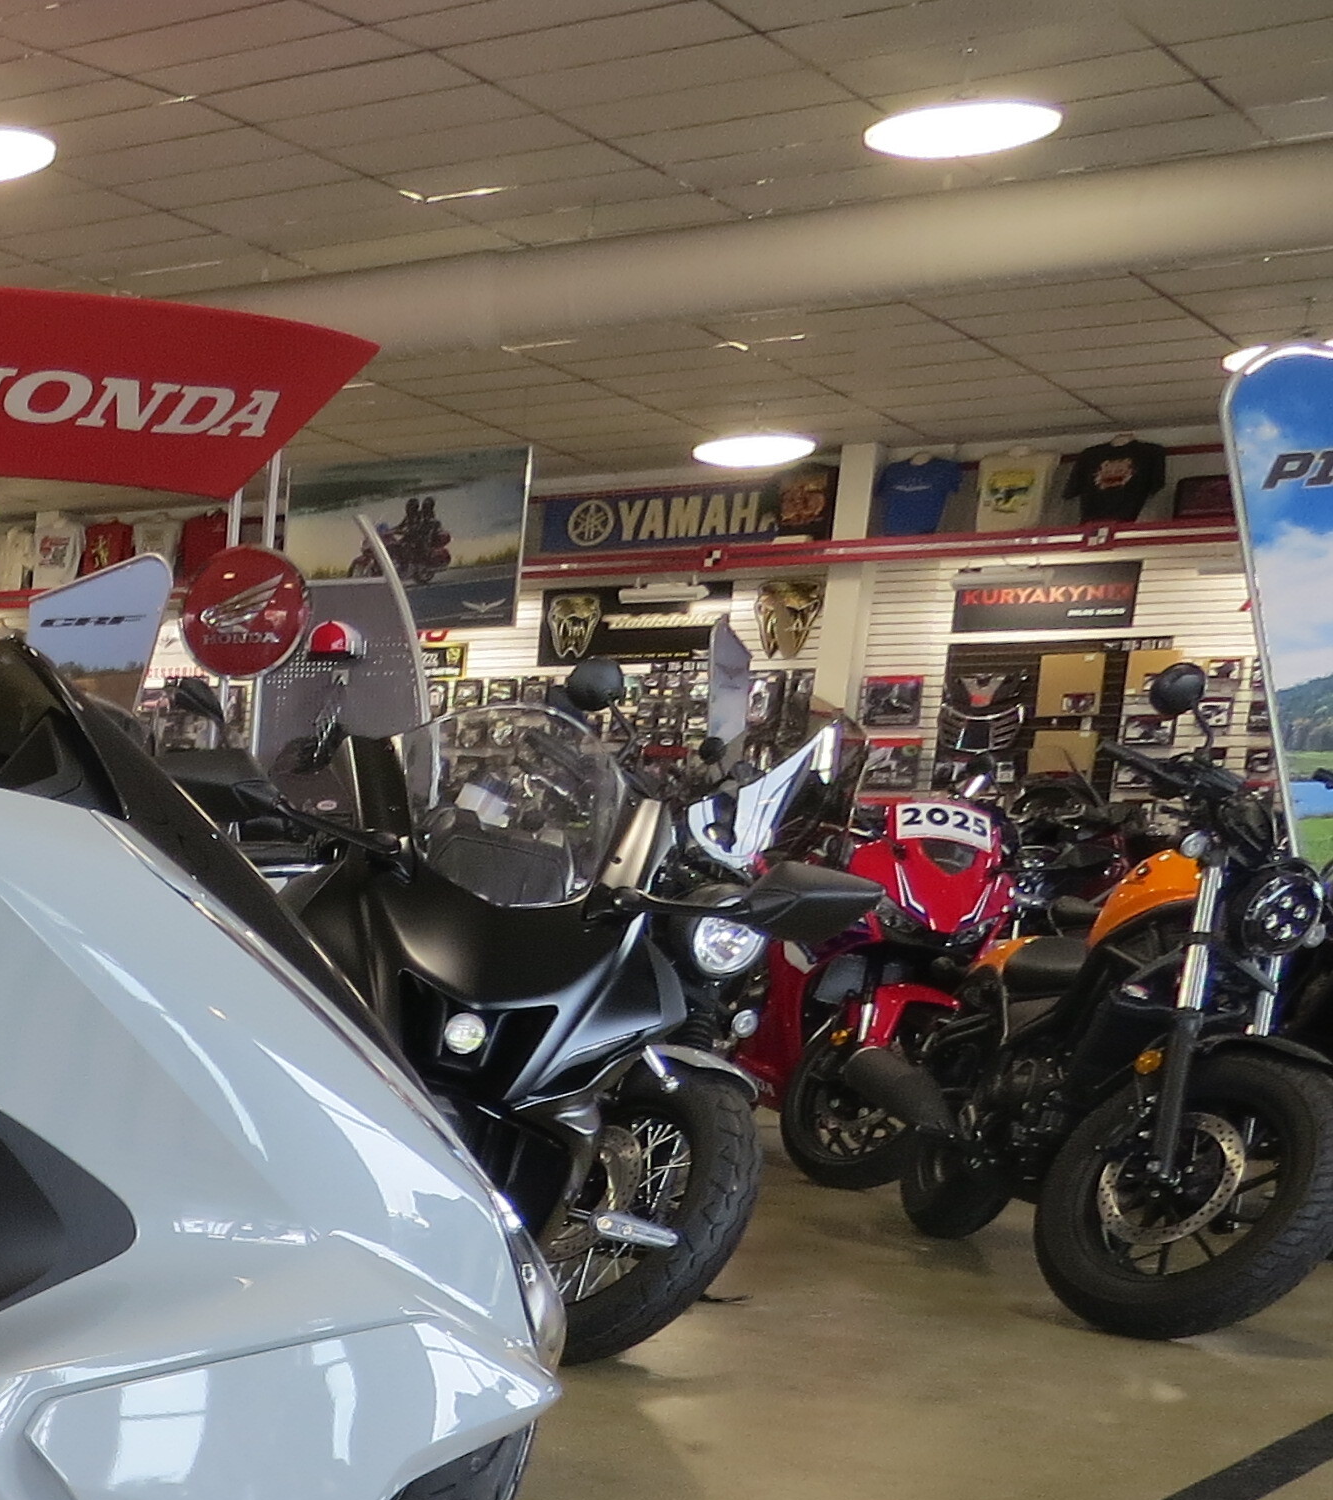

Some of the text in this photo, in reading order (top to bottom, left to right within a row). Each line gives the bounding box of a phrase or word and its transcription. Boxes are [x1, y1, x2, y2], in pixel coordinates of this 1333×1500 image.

[1261, 451, 1333, 490] PI
[39, 614, 147, 628] CRF
[202, 631, 280, 645] HONDA
[901, 807, 988, 838] 2025
